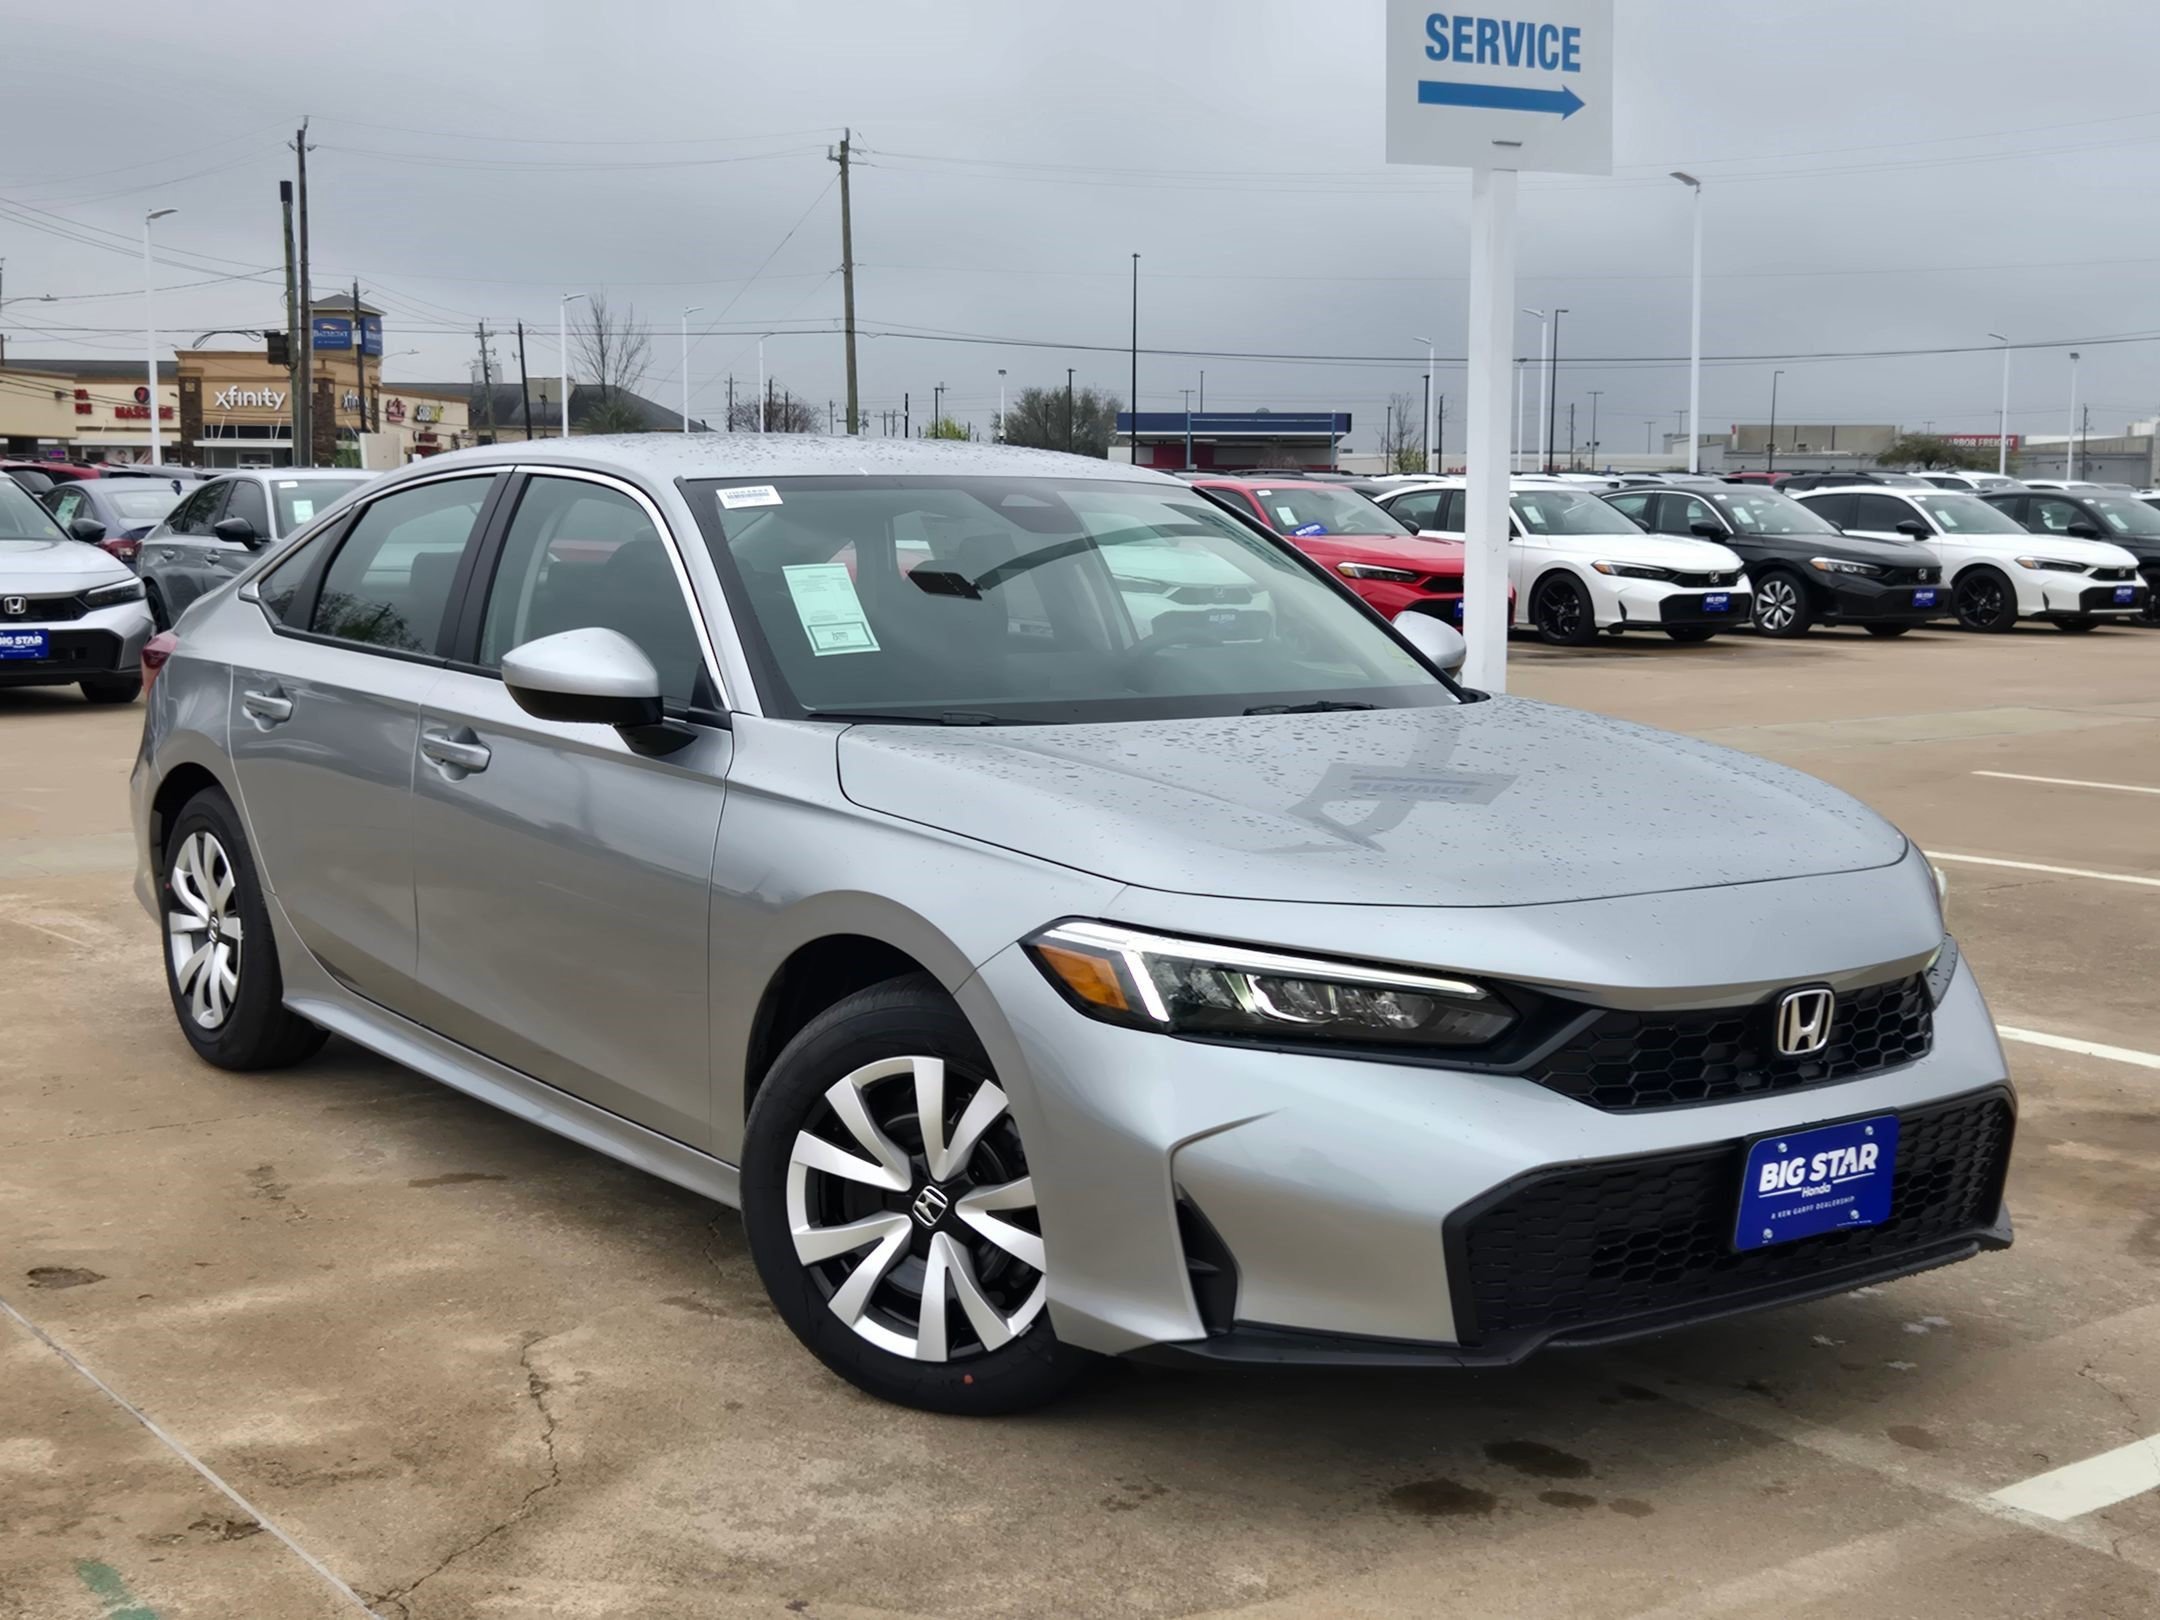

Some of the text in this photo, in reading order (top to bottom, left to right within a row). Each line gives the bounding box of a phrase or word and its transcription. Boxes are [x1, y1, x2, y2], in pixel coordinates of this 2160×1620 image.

[1425, 13, 1581, 72] SERVICE
[215, 385, 286, 411] xfinity
[15, 635, 43, 645] STAR
[1758, 1142, 1879, 1192] BIG STAR
[1802, 1182, 1832, 1198] Honda
[1777, 1209, 1792, 1218] KEN
[1815, 1196, 1855, 1210] DEALERSHIP
